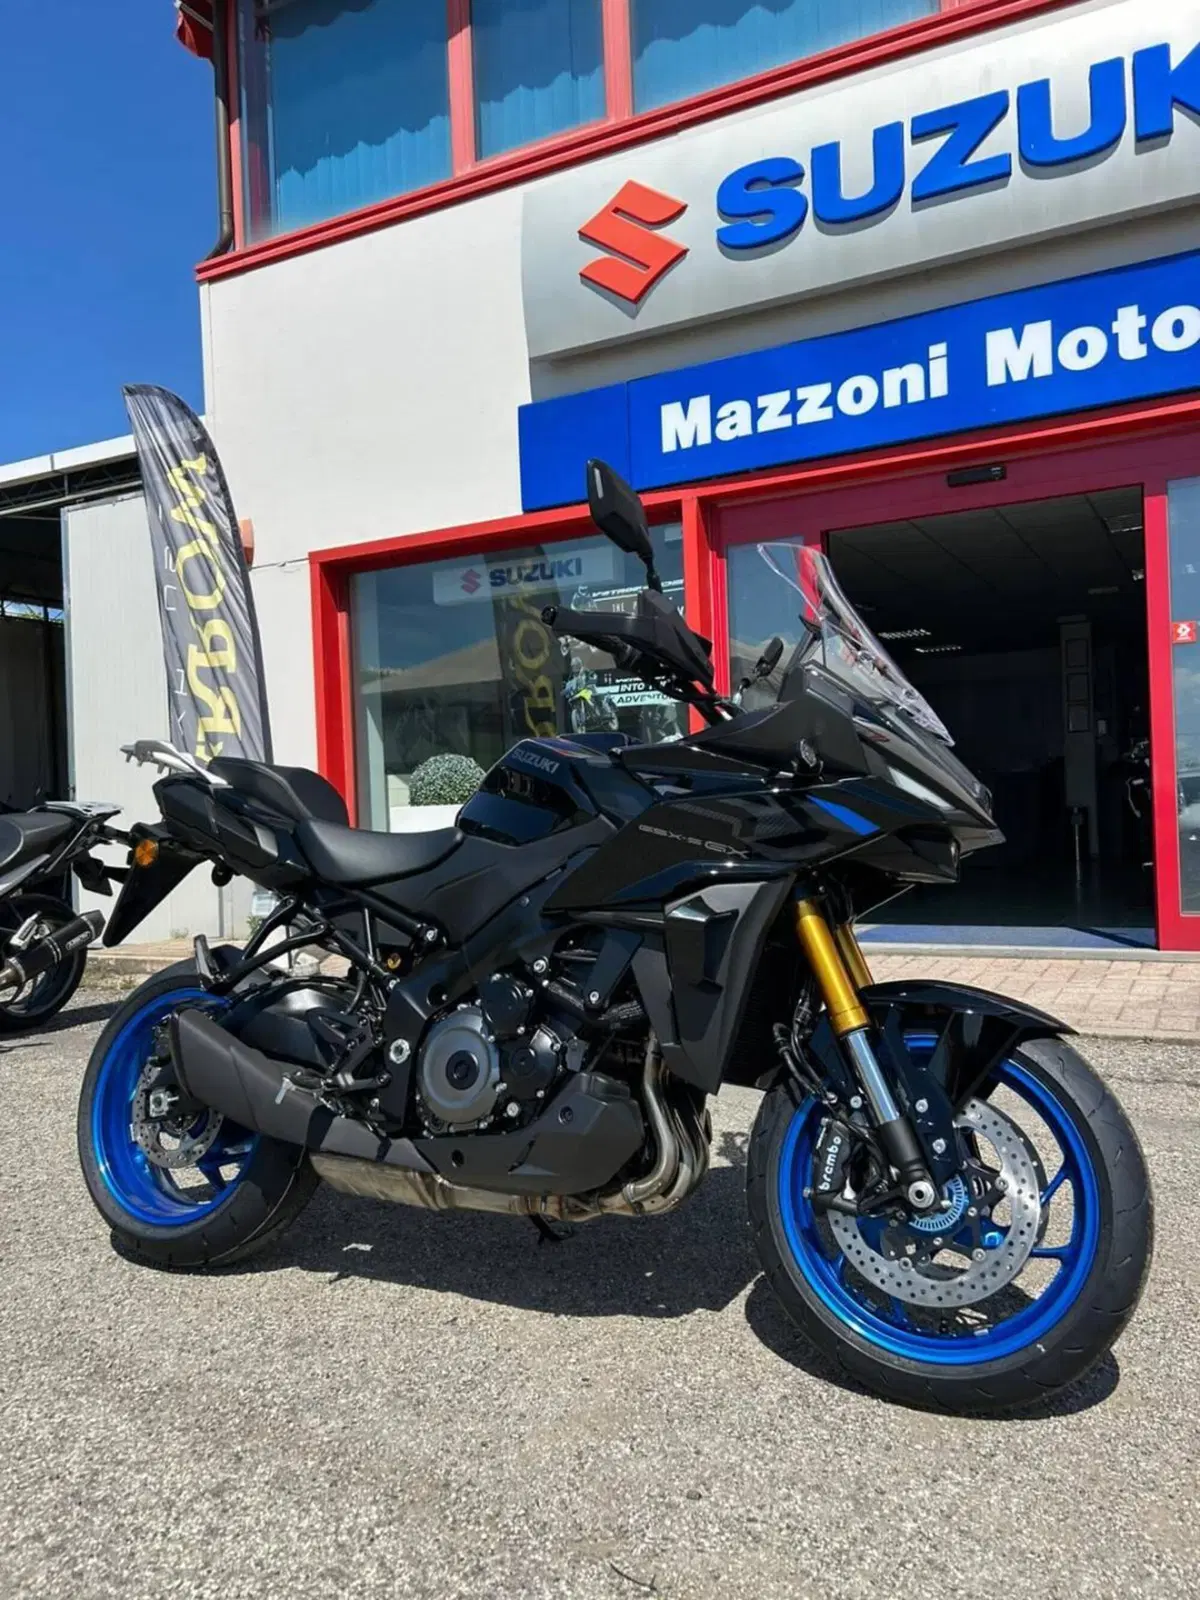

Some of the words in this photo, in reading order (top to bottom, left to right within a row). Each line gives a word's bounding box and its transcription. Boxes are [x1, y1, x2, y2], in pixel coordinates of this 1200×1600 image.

[716, 41, 1200, 249] SUZUK
[661, 342, 948, 453] Mazzoni
[986, 304, 1200, 387] Moto
[489, 557, 582, 587] SUZUKI
[512, 748, 560, 775] SUZUKI
[818, 1136, 841, 1191] brembo
